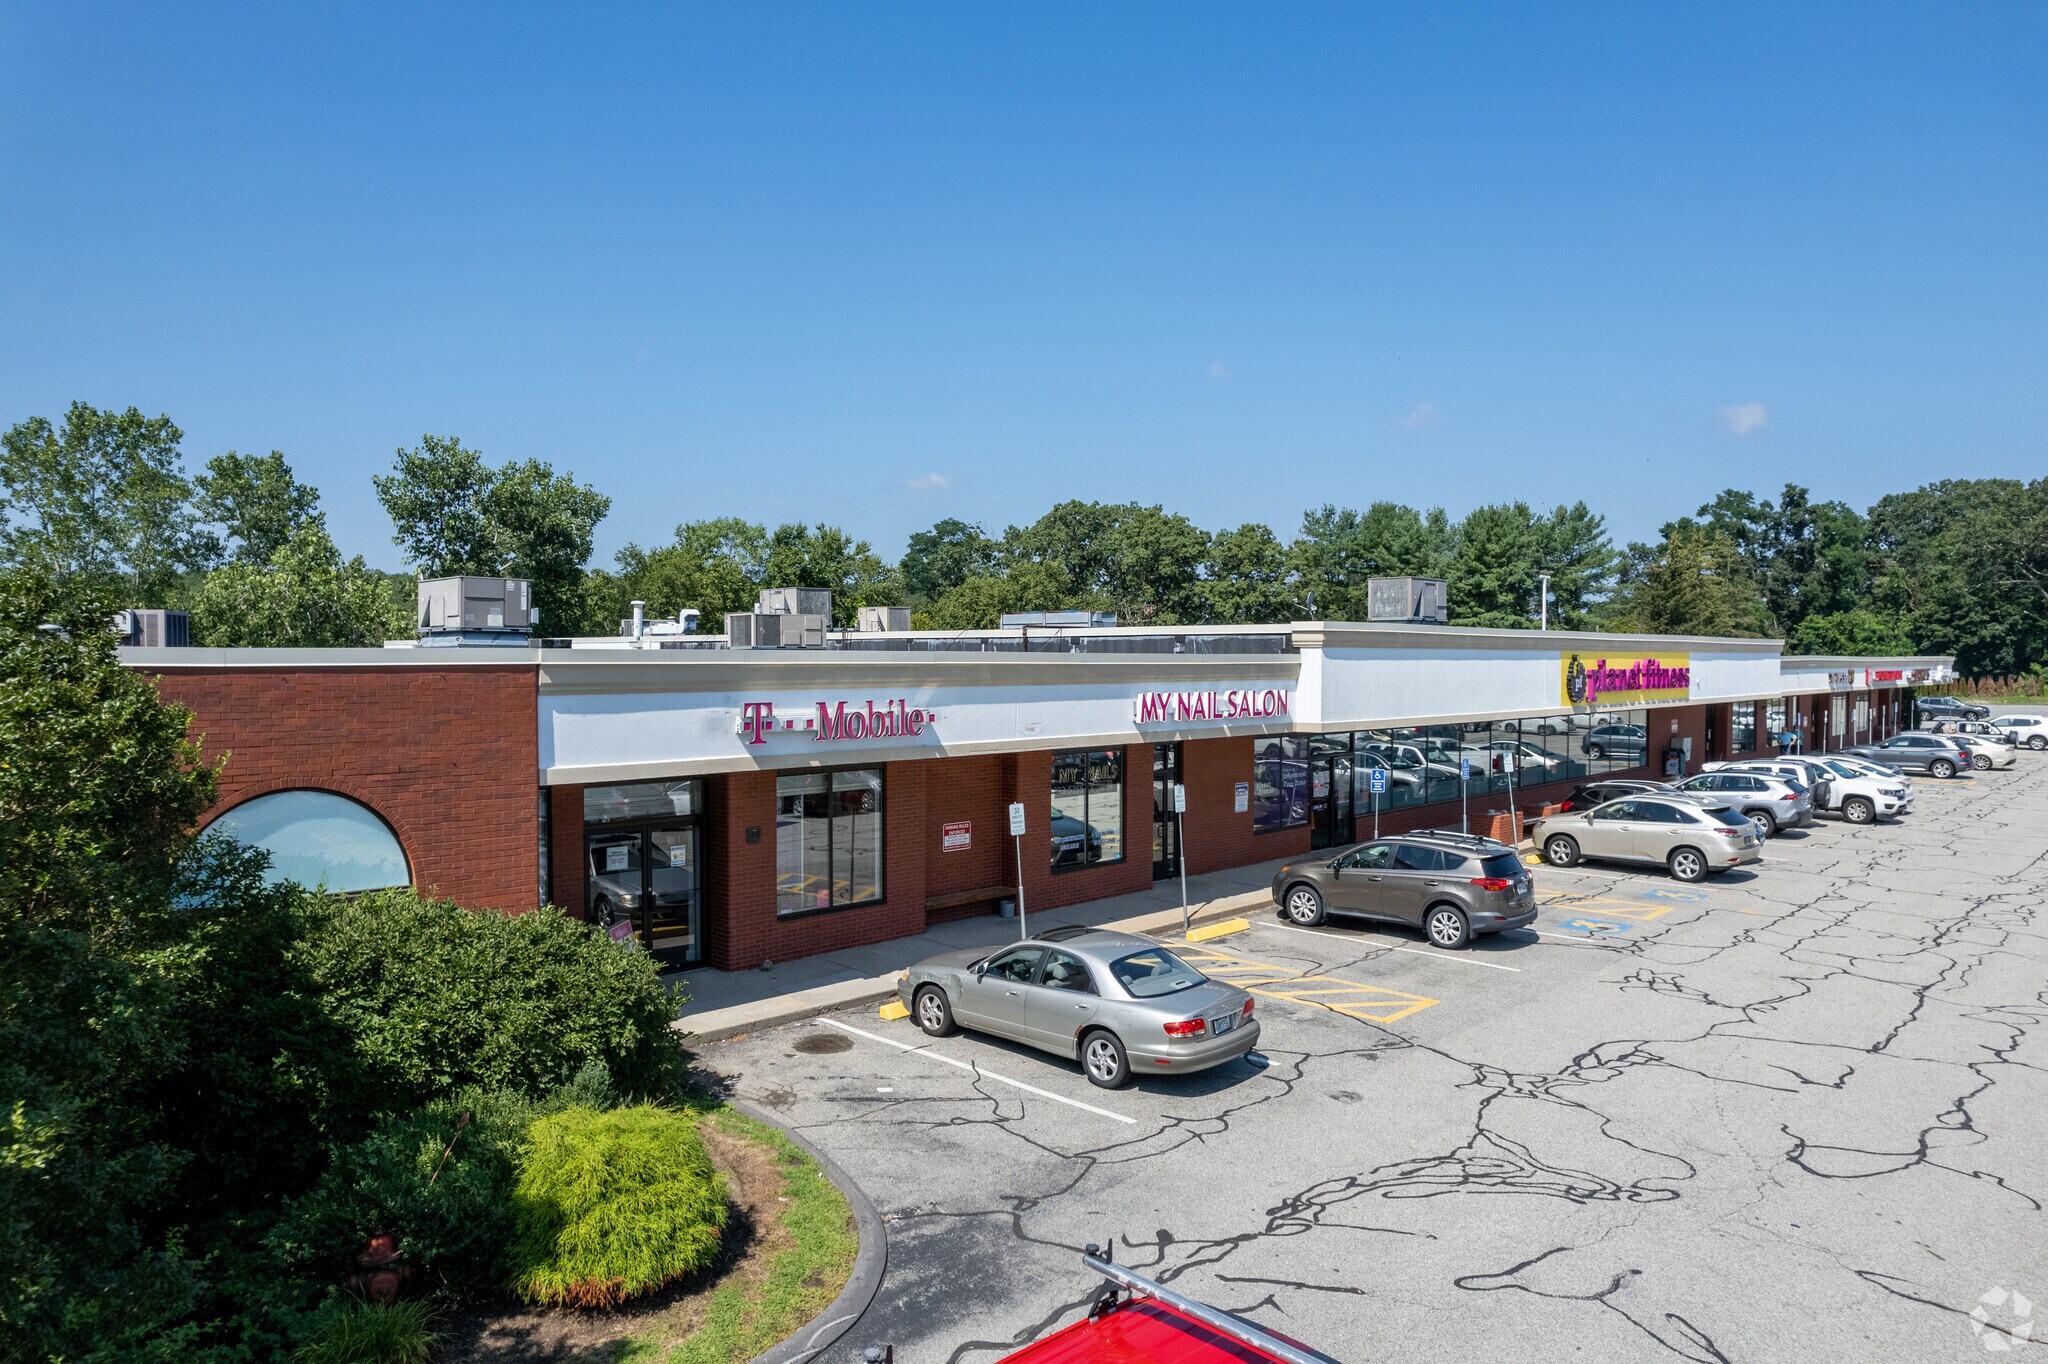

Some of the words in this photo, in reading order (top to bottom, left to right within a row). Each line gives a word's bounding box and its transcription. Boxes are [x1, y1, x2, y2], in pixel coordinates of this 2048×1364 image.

[1586, 658, 1641, 702] planet
[1642, 658, 1690, 690] fitness
[1140, 692, 1172, 723] MY
[1177, 690, 1224, 721] NAIL
[1226, 688, 1289, 718] SALON
[1059, 767, 1078, 783] MY
